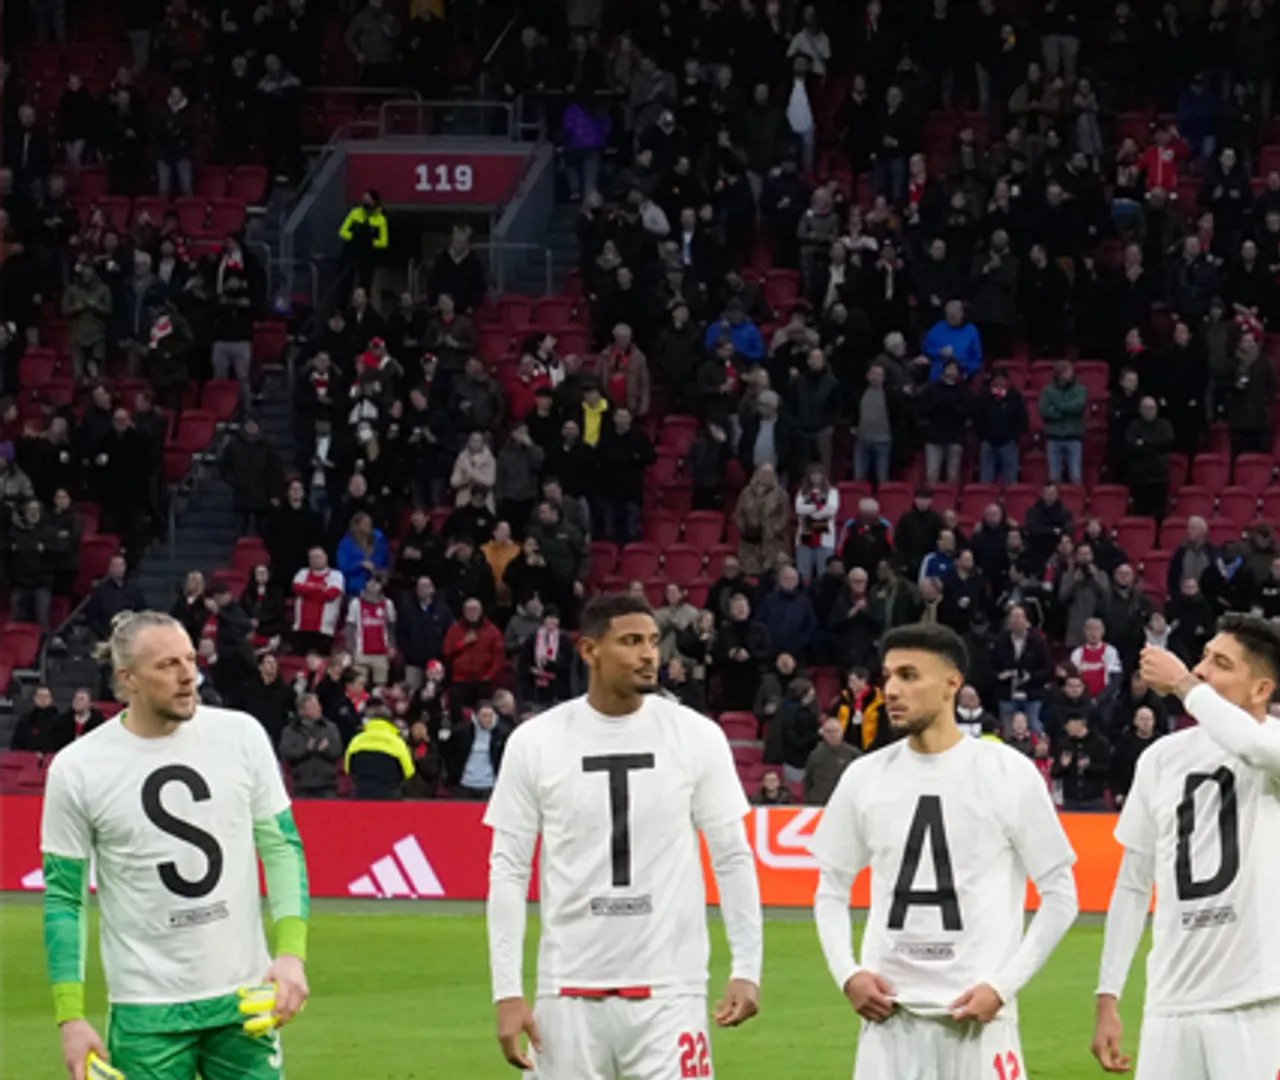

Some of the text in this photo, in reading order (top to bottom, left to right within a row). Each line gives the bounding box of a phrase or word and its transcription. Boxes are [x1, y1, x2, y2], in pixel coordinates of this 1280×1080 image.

[415, 164, 473, 192] 119
[141, 764, 223, 898] S
[582, 753, 655, 888] T
[887, 795, 963, 932] A
[1175, 765, 1240, 901] D
[678, 1031, 711, 1078] 22
